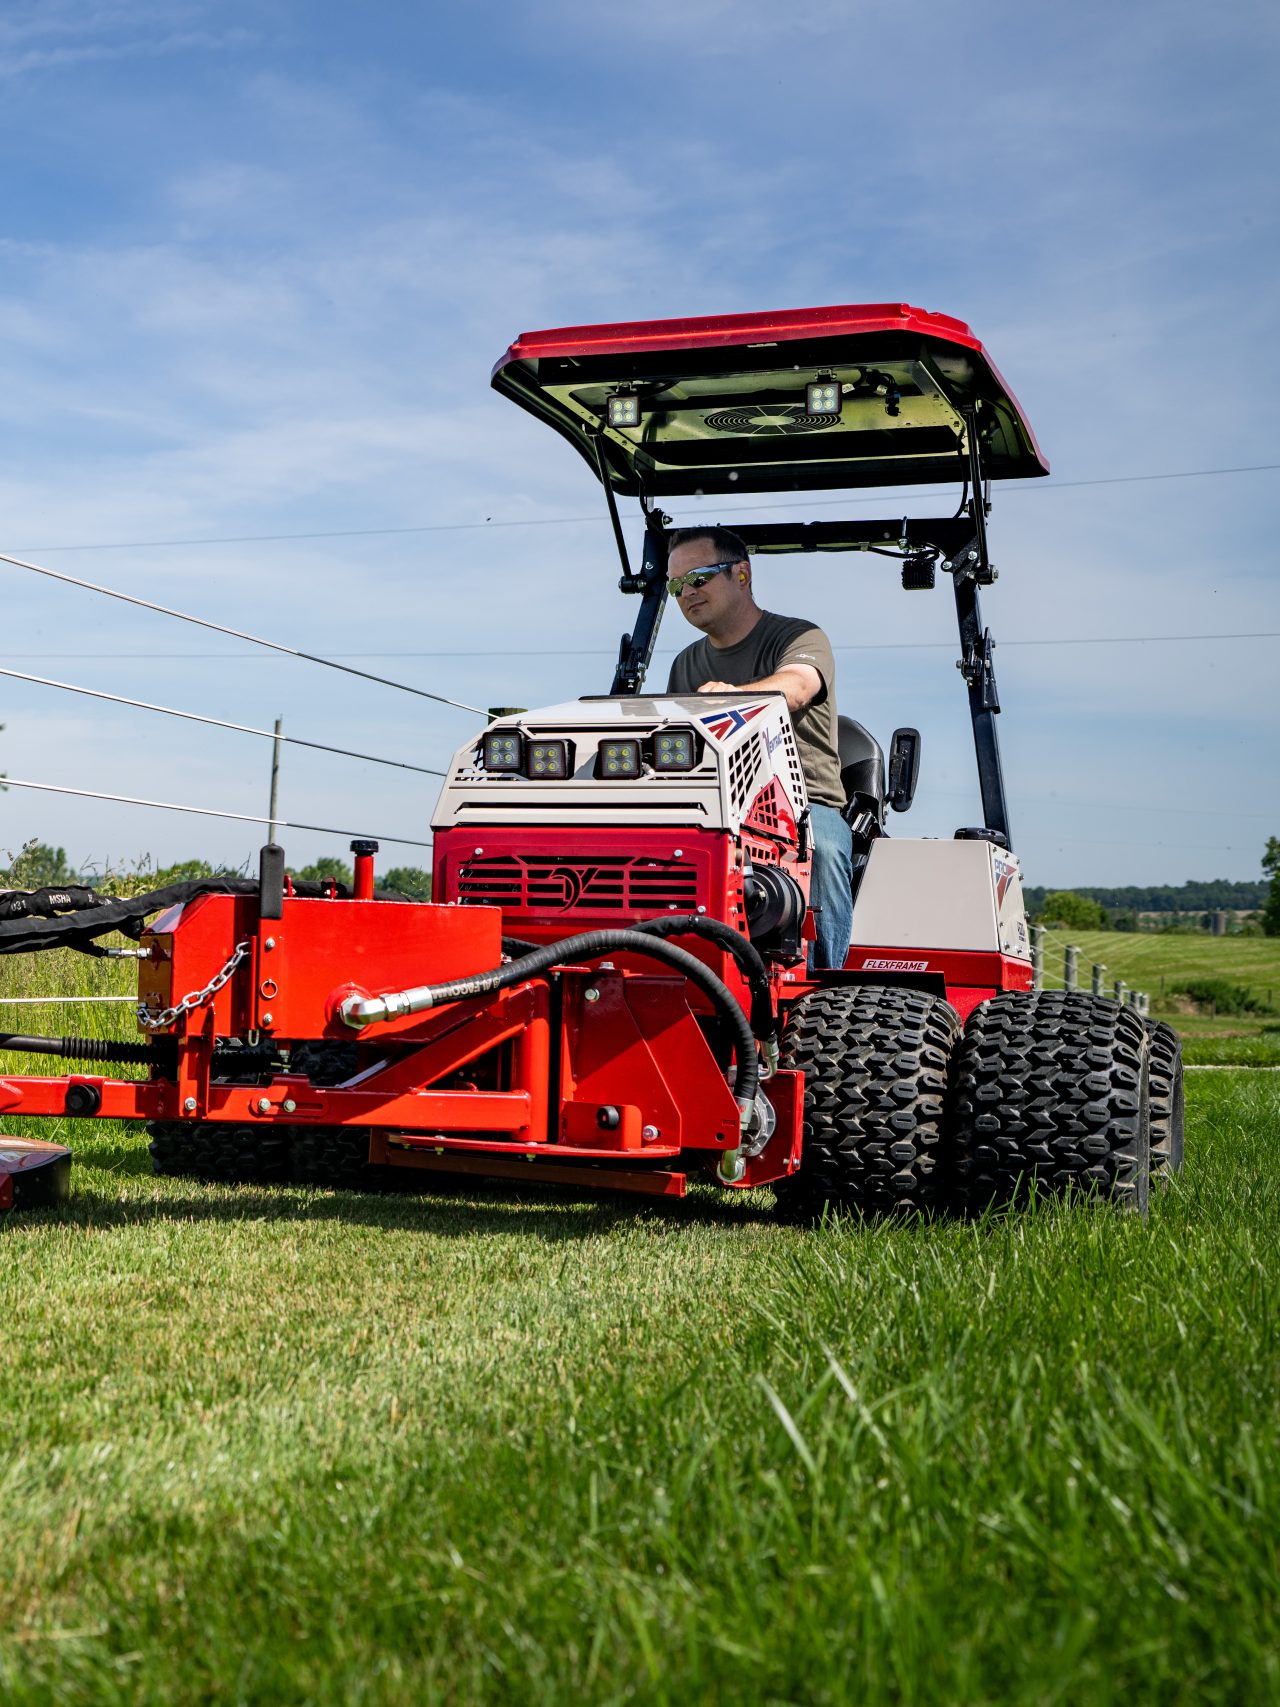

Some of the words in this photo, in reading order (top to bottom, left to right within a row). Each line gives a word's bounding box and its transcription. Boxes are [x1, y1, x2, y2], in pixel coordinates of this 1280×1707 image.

[994, 858, 1008, 876] PRO
[48, 893, 71, 905] MSHA
[866, 960, 924, 971] FLEXFRAME
